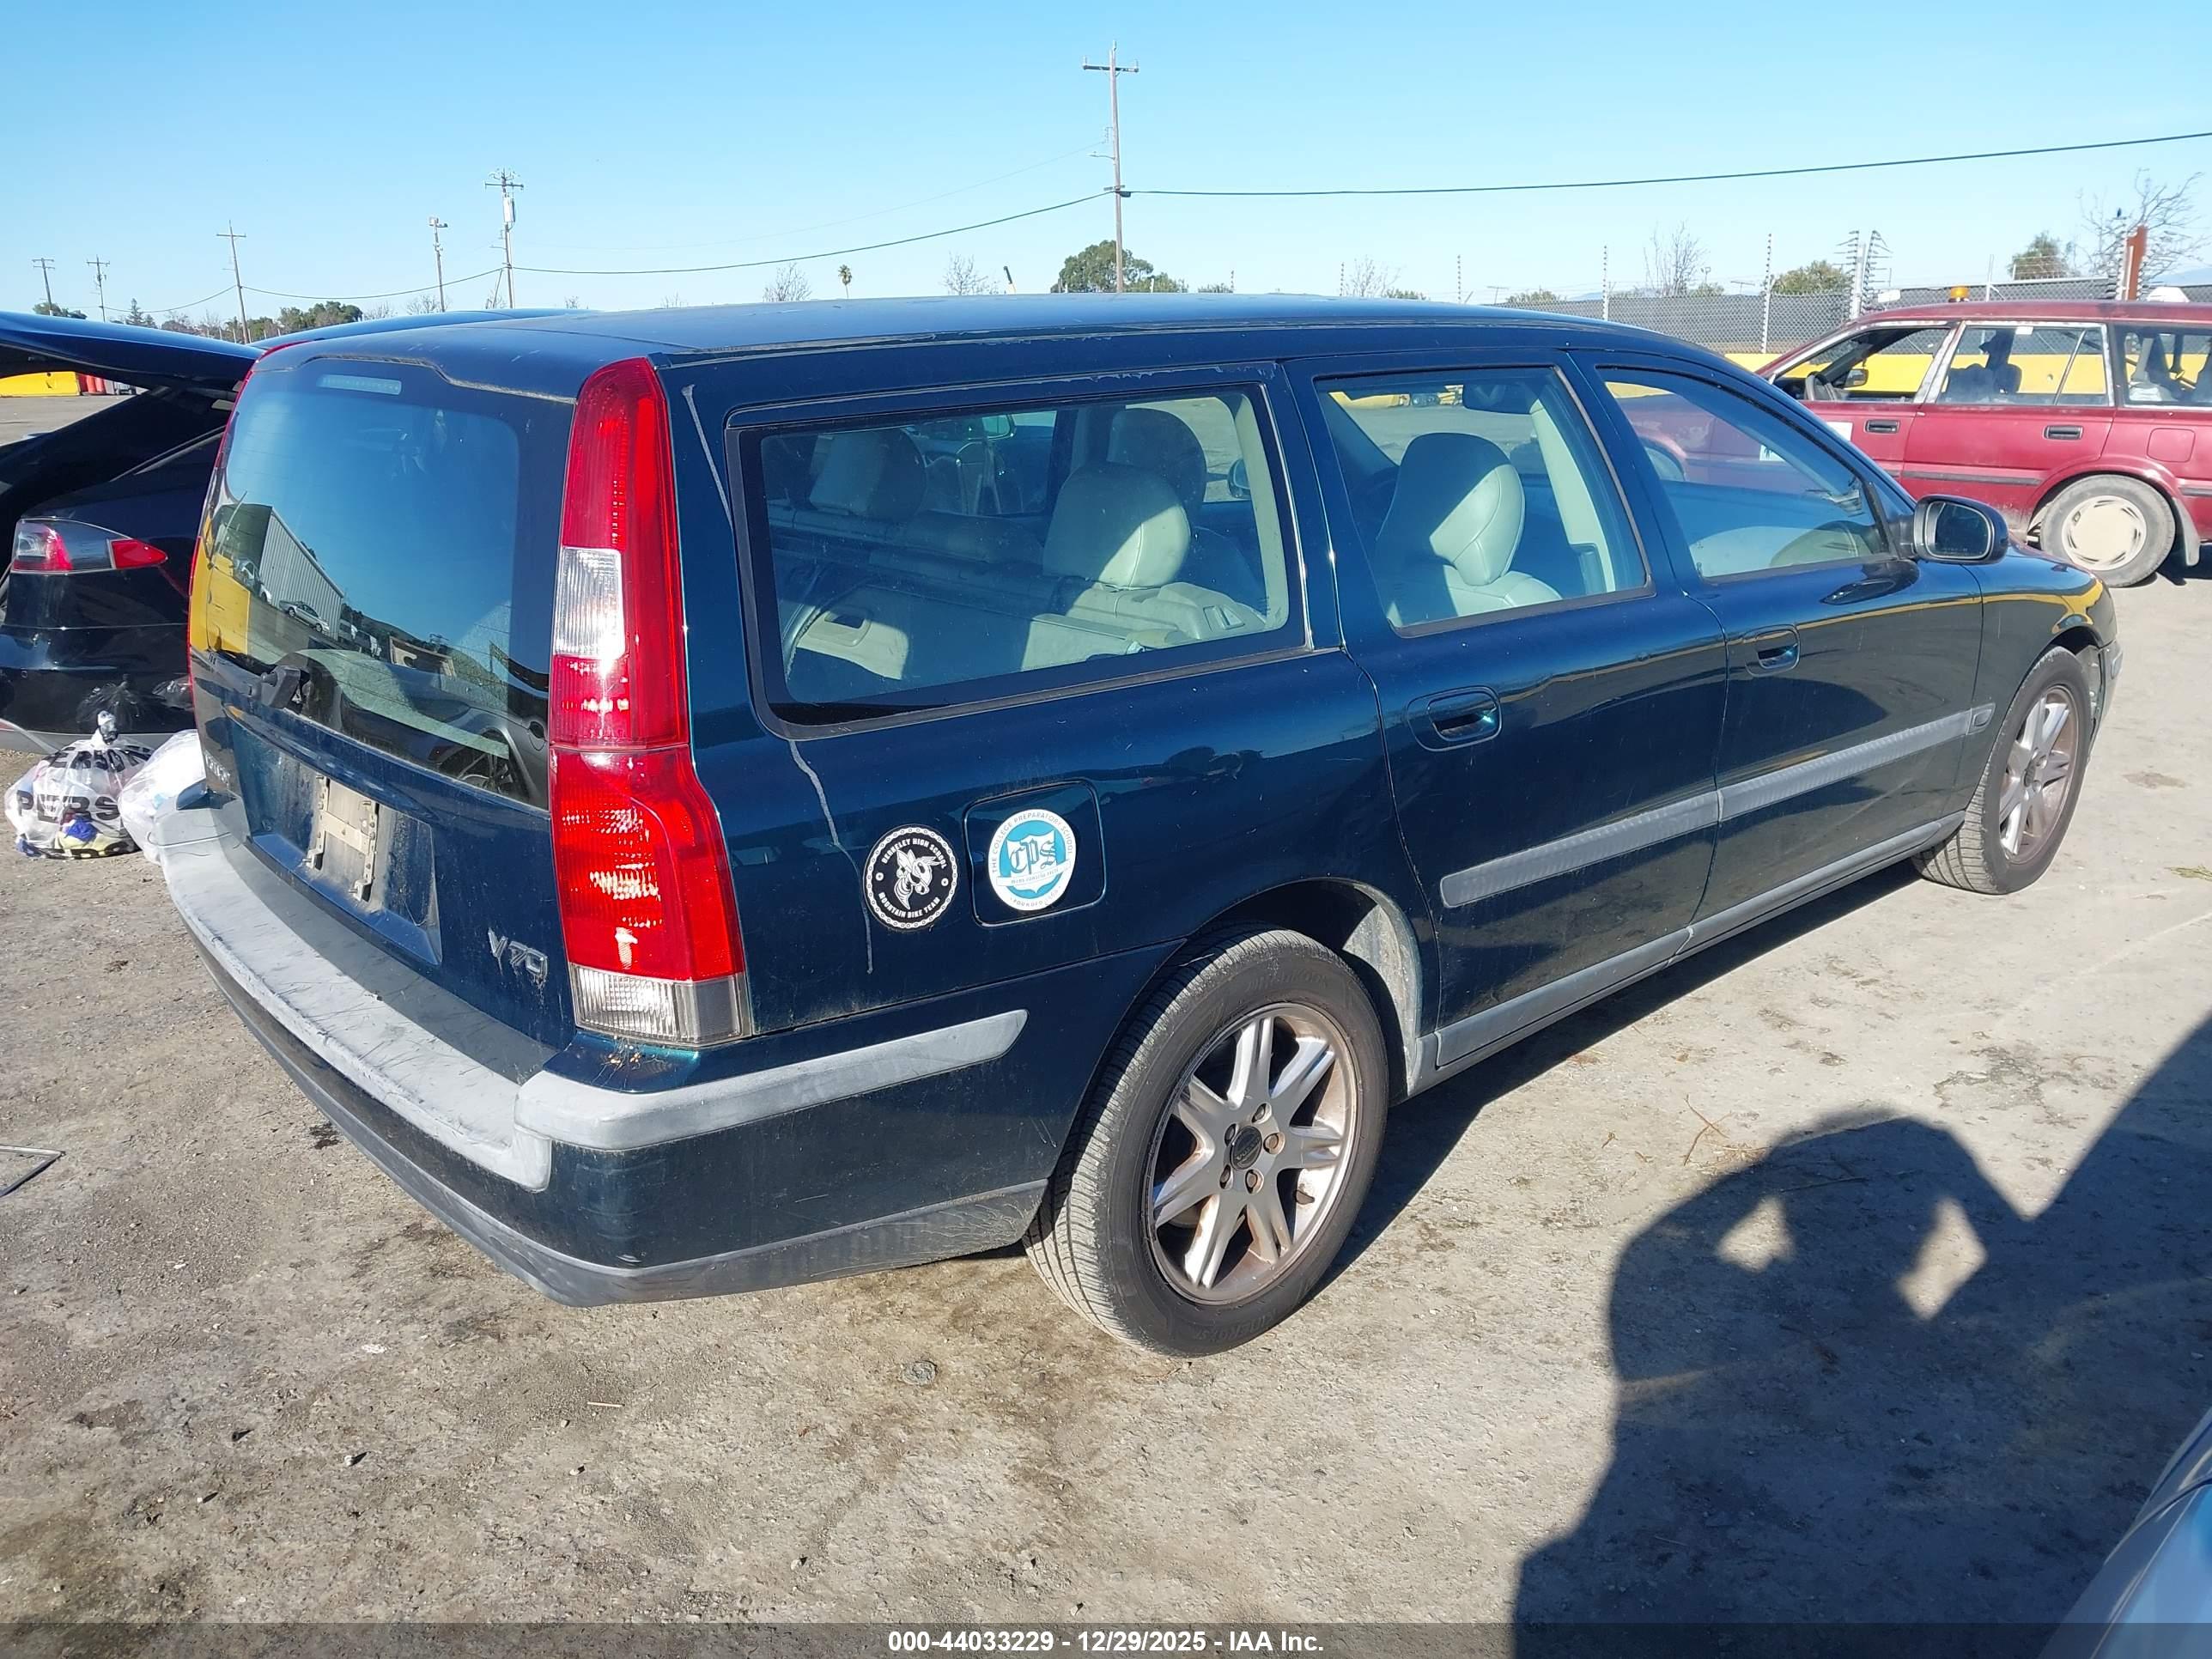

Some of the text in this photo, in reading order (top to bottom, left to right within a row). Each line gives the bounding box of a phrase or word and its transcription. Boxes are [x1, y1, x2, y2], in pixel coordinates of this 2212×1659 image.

[994, 821, 1012, 852] COLLEGE
[1013, 812, 1061, 826] PREPARATORY
[1060, 825, 1073, 854] SCHOOL
[881, 838, 947, 869] BERKELEY HIGH SCHOOL
[878, 891, 941, 919] MOUNTAIN BIKE TEAM
[488, 928, 548, 976] V70
